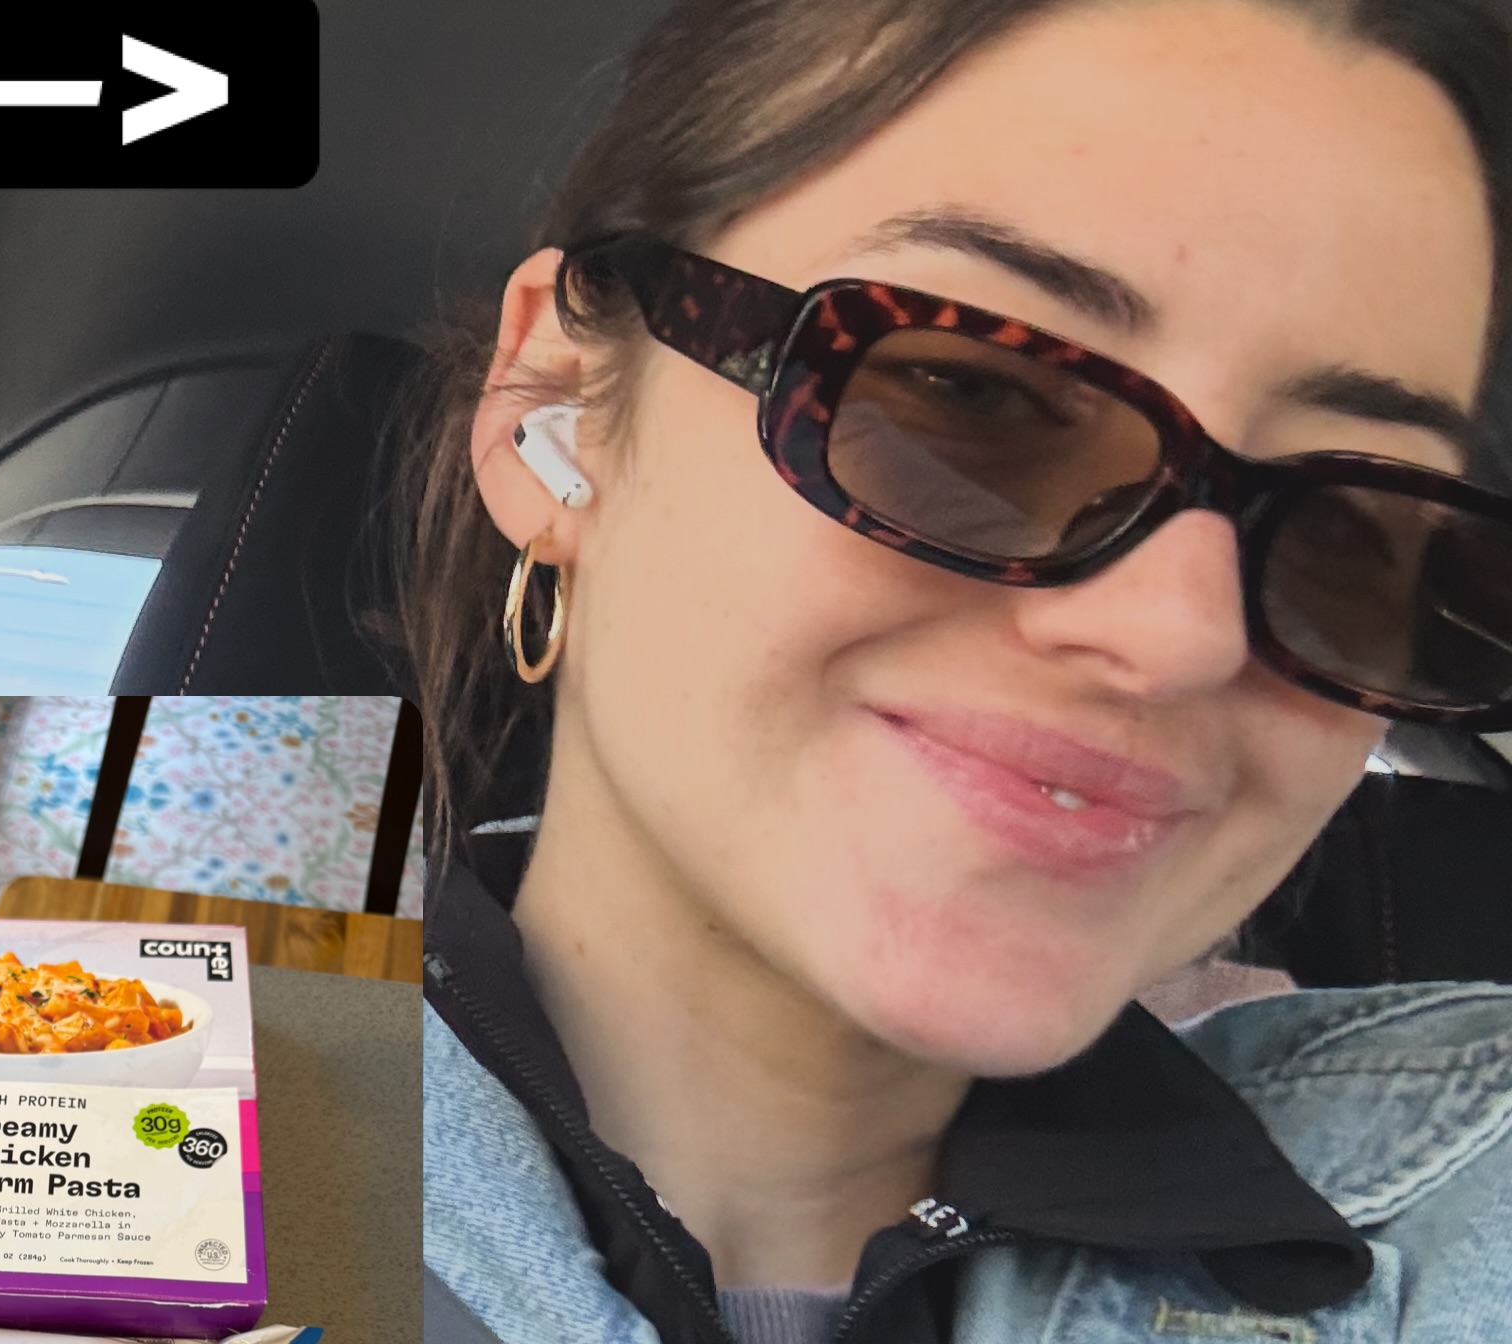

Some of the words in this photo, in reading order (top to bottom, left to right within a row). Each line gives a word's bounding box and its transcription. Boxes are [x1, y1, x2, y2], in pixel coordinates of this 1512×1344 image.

[17, 1094, 87, 1110] PROTEIN
[140, 1115, 182, 1134] 30g
[182, 1137, 224, 1159] 360
[48, 1173, 141, 1199] Pasta
[45, 1207, 79, 1218] White
[45, 1219, 111, 1230] Mozzarella
[117, 1220, 131, 1230] in
[12, 1229, 52, 1240] Tomato
[58, 1231, 111, 1242] Parmesan
[117, 1232, 152, 1242] Sauce
